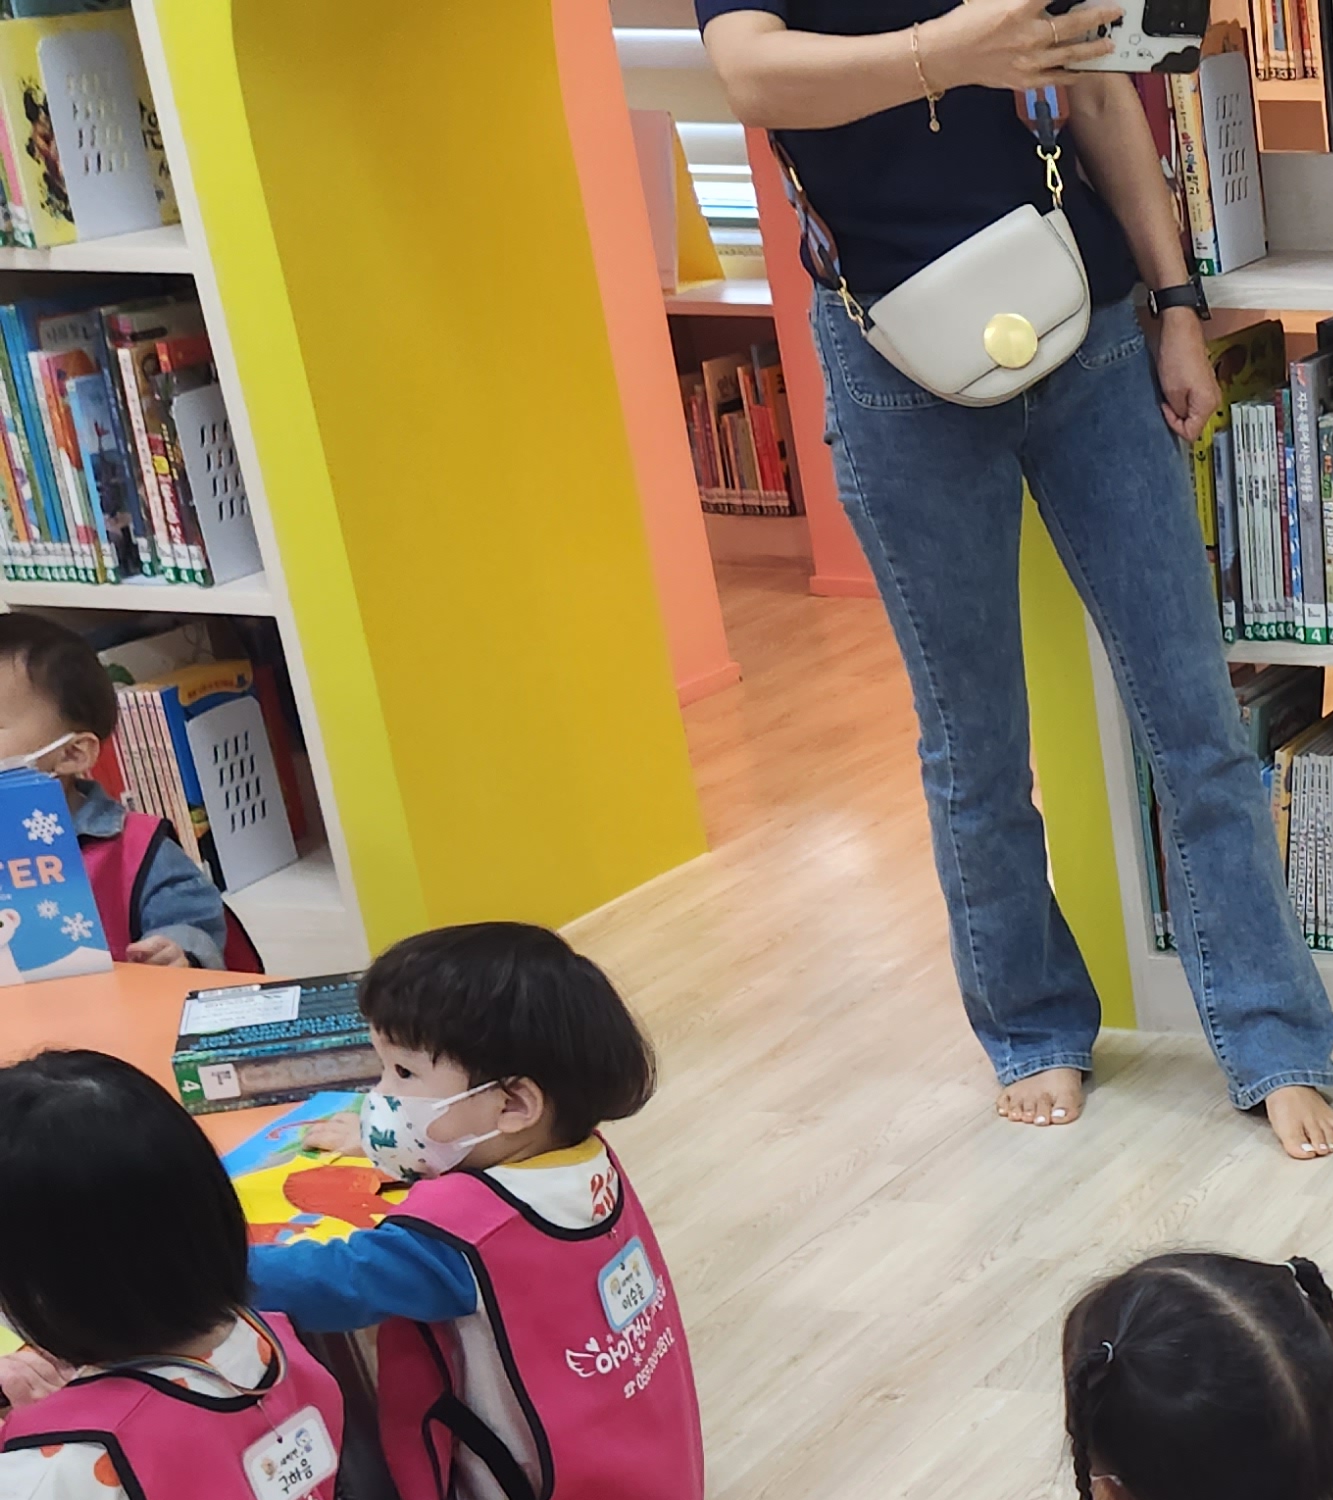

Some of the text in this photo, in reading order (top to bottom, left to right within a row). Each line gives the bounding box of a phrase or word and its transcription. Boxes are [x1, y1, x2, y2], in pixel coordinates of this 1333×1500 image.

[1198, 260, 1209, 275] 4
[0, 856, 66, 889] ER
[181, 1079, 201, 1093] 4
